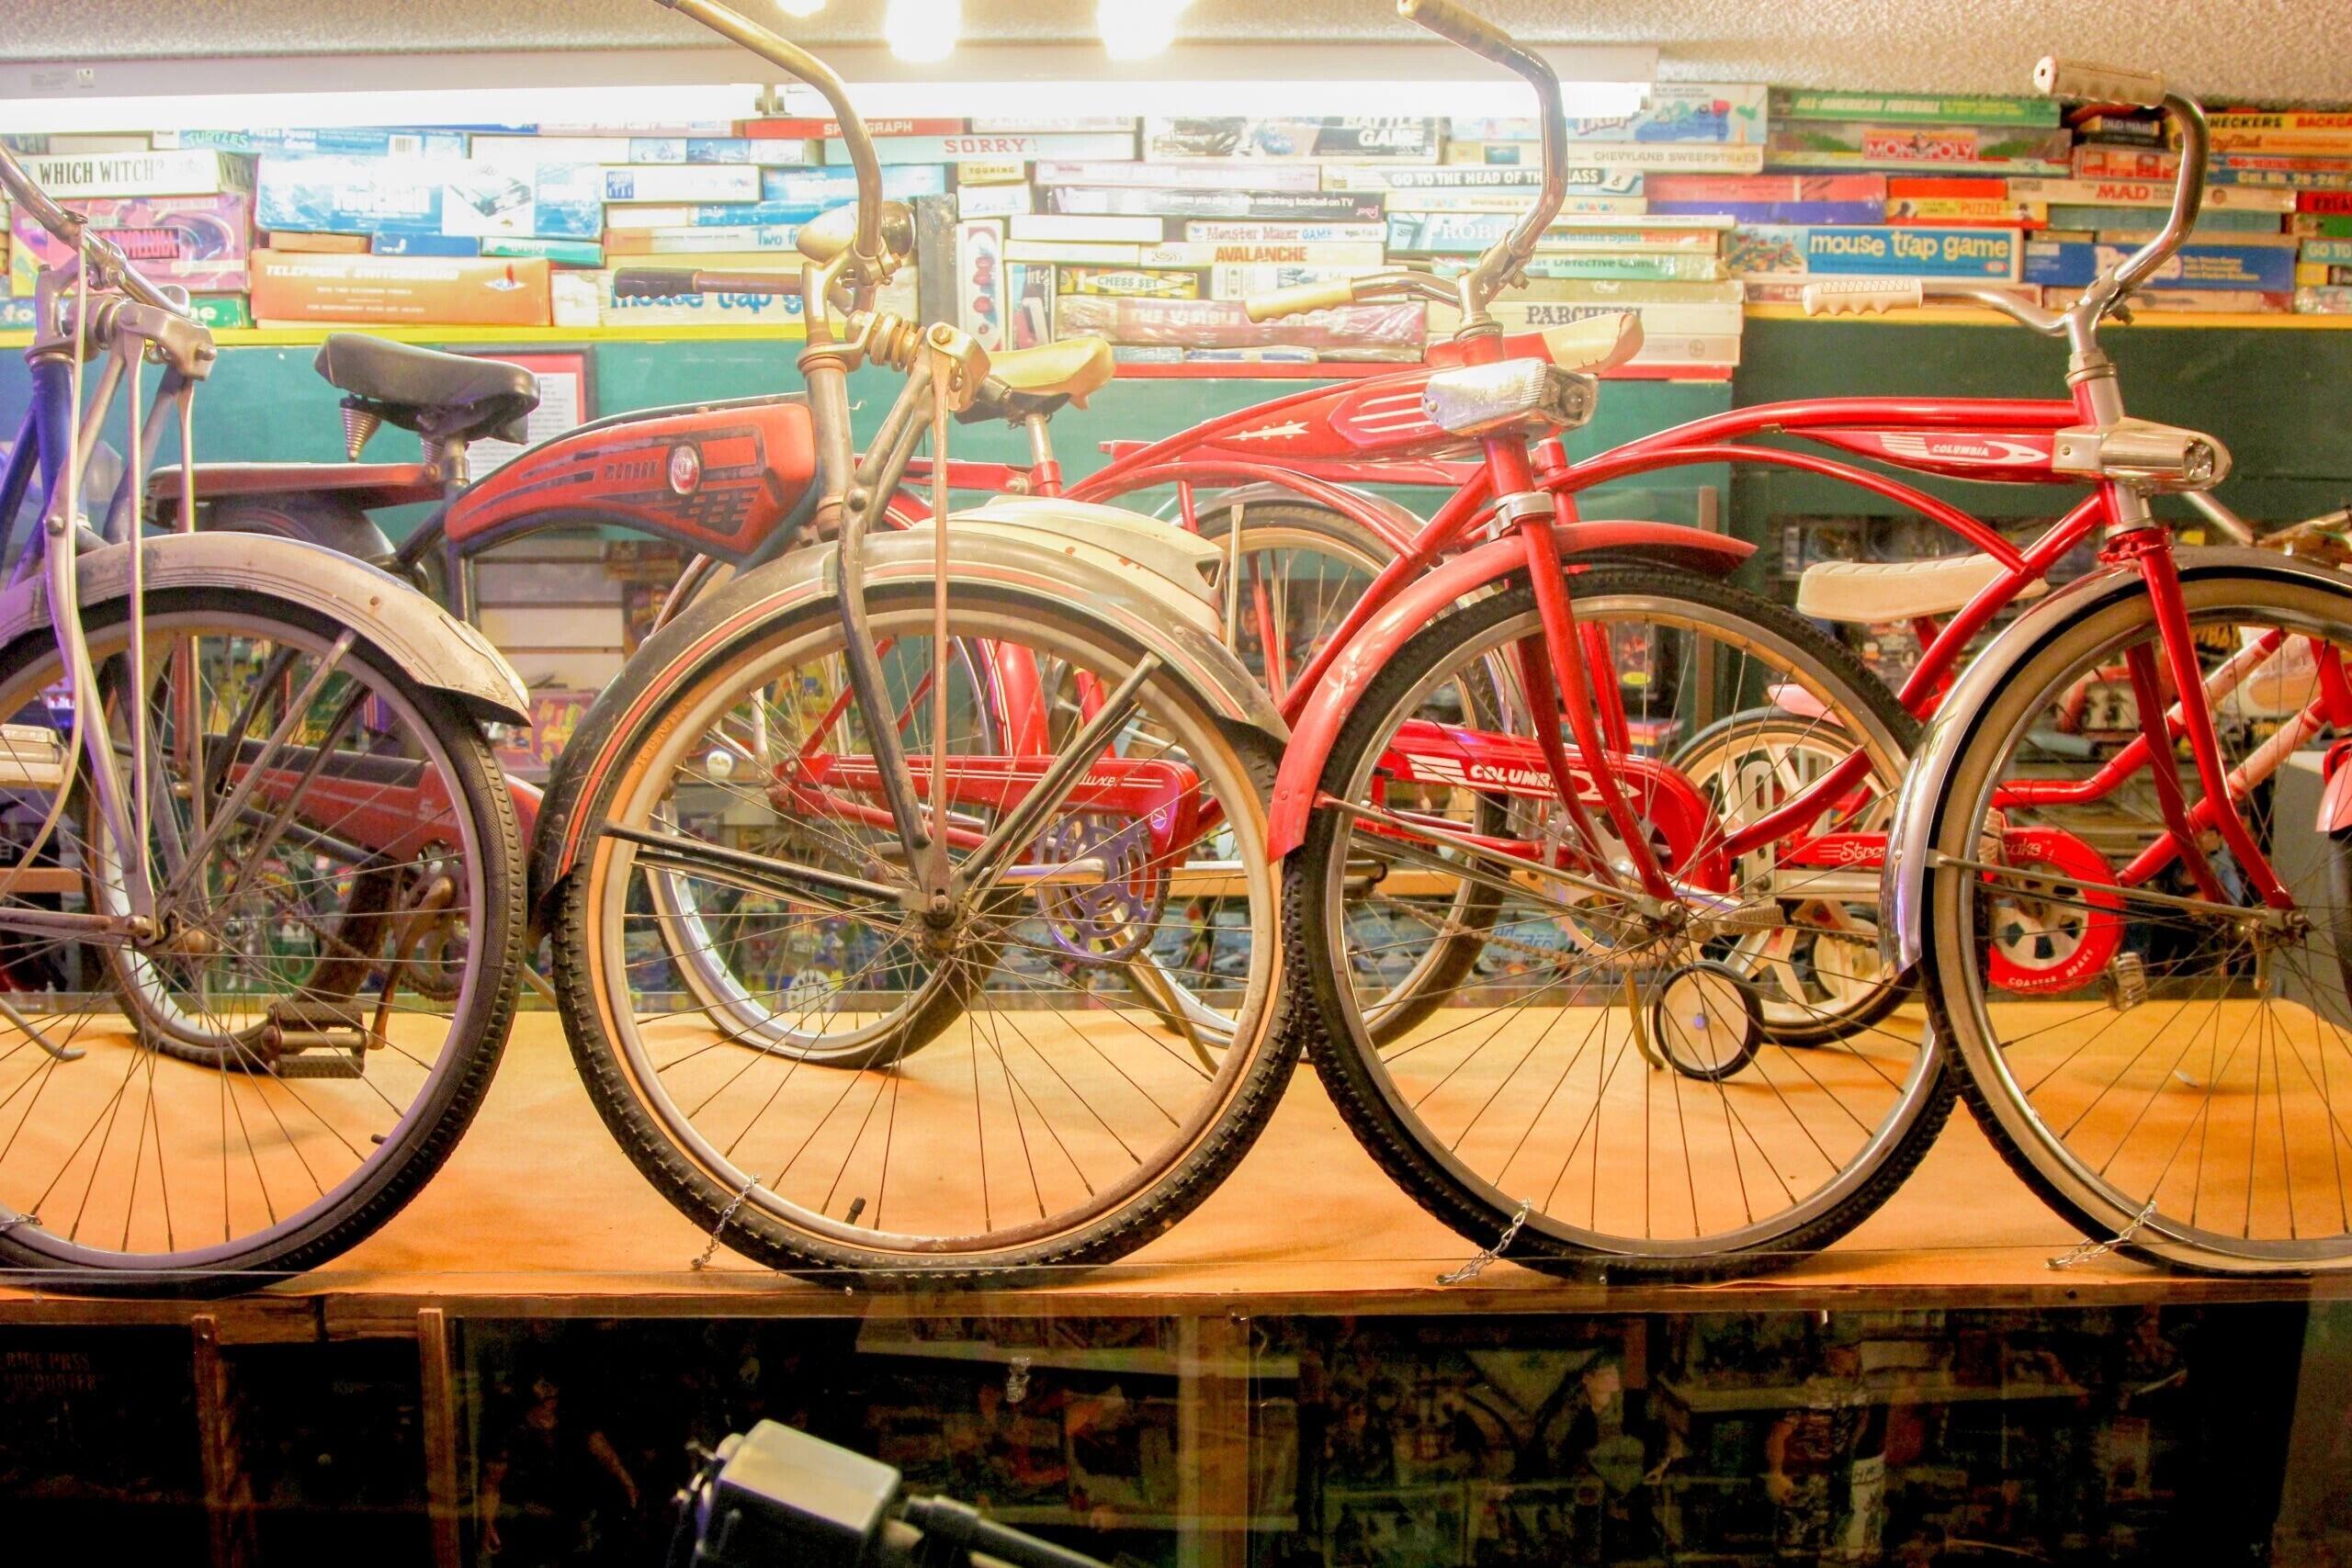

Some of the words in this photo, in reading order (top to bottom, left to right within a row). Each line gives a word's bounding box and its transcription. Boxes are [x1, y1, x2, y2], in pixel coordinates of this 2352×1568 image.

[823, 120, 912, 136] SPGRAPH
[2206, 117, 2282, 128] HECKERS
[944, 138, 1038, 154] SORRY!
[1359, 129, 1425, 147] GAME
[1668, 152, 1759, 164] SWEEPSTAKES
[1868, 140, 1974, 160] MONPOLY
[39, 161, 94, 185] WHICH
[99, 158, 165, 183] WITCH?
[1392, 172, 1413, 186] GO
[1416, 172, 1434, 185] TO
[1437, 171, 1461, 185] THE
[1464, 171, 1498, 184] HEAD
[1504, 170, 1521, 184] OF
[1525, 171, 1544, 184] TH
[1567, 169, 1599, 183] LASS
[2097, 184, 2149, 199] MAD
[1295, 197, 1328, 207] football
[1329, 198, 1340, 207] on
[1340, 197, 1354, 207] TV
[751, 226, 783, 246] Two
[1216, 245, 1307, 263] AVALANCHE
[1810, 234, 1885, 257] mouse
[1891, 230, 1938, 261] trap
[1943, 234, 2009, 261] game
[1097, 276, 1134, 288] CHESS
[1138, 276, 1159, 288] SET
[1932, 444, 1990, 457] COLUMBIA
[1079, 771, 1117, 788] luxe
[1470, 764, 1557, 788] COLUMB
[2008, 976, 2057, 987] COASTER
[2065, 948, 2094, 978] BRAKE
